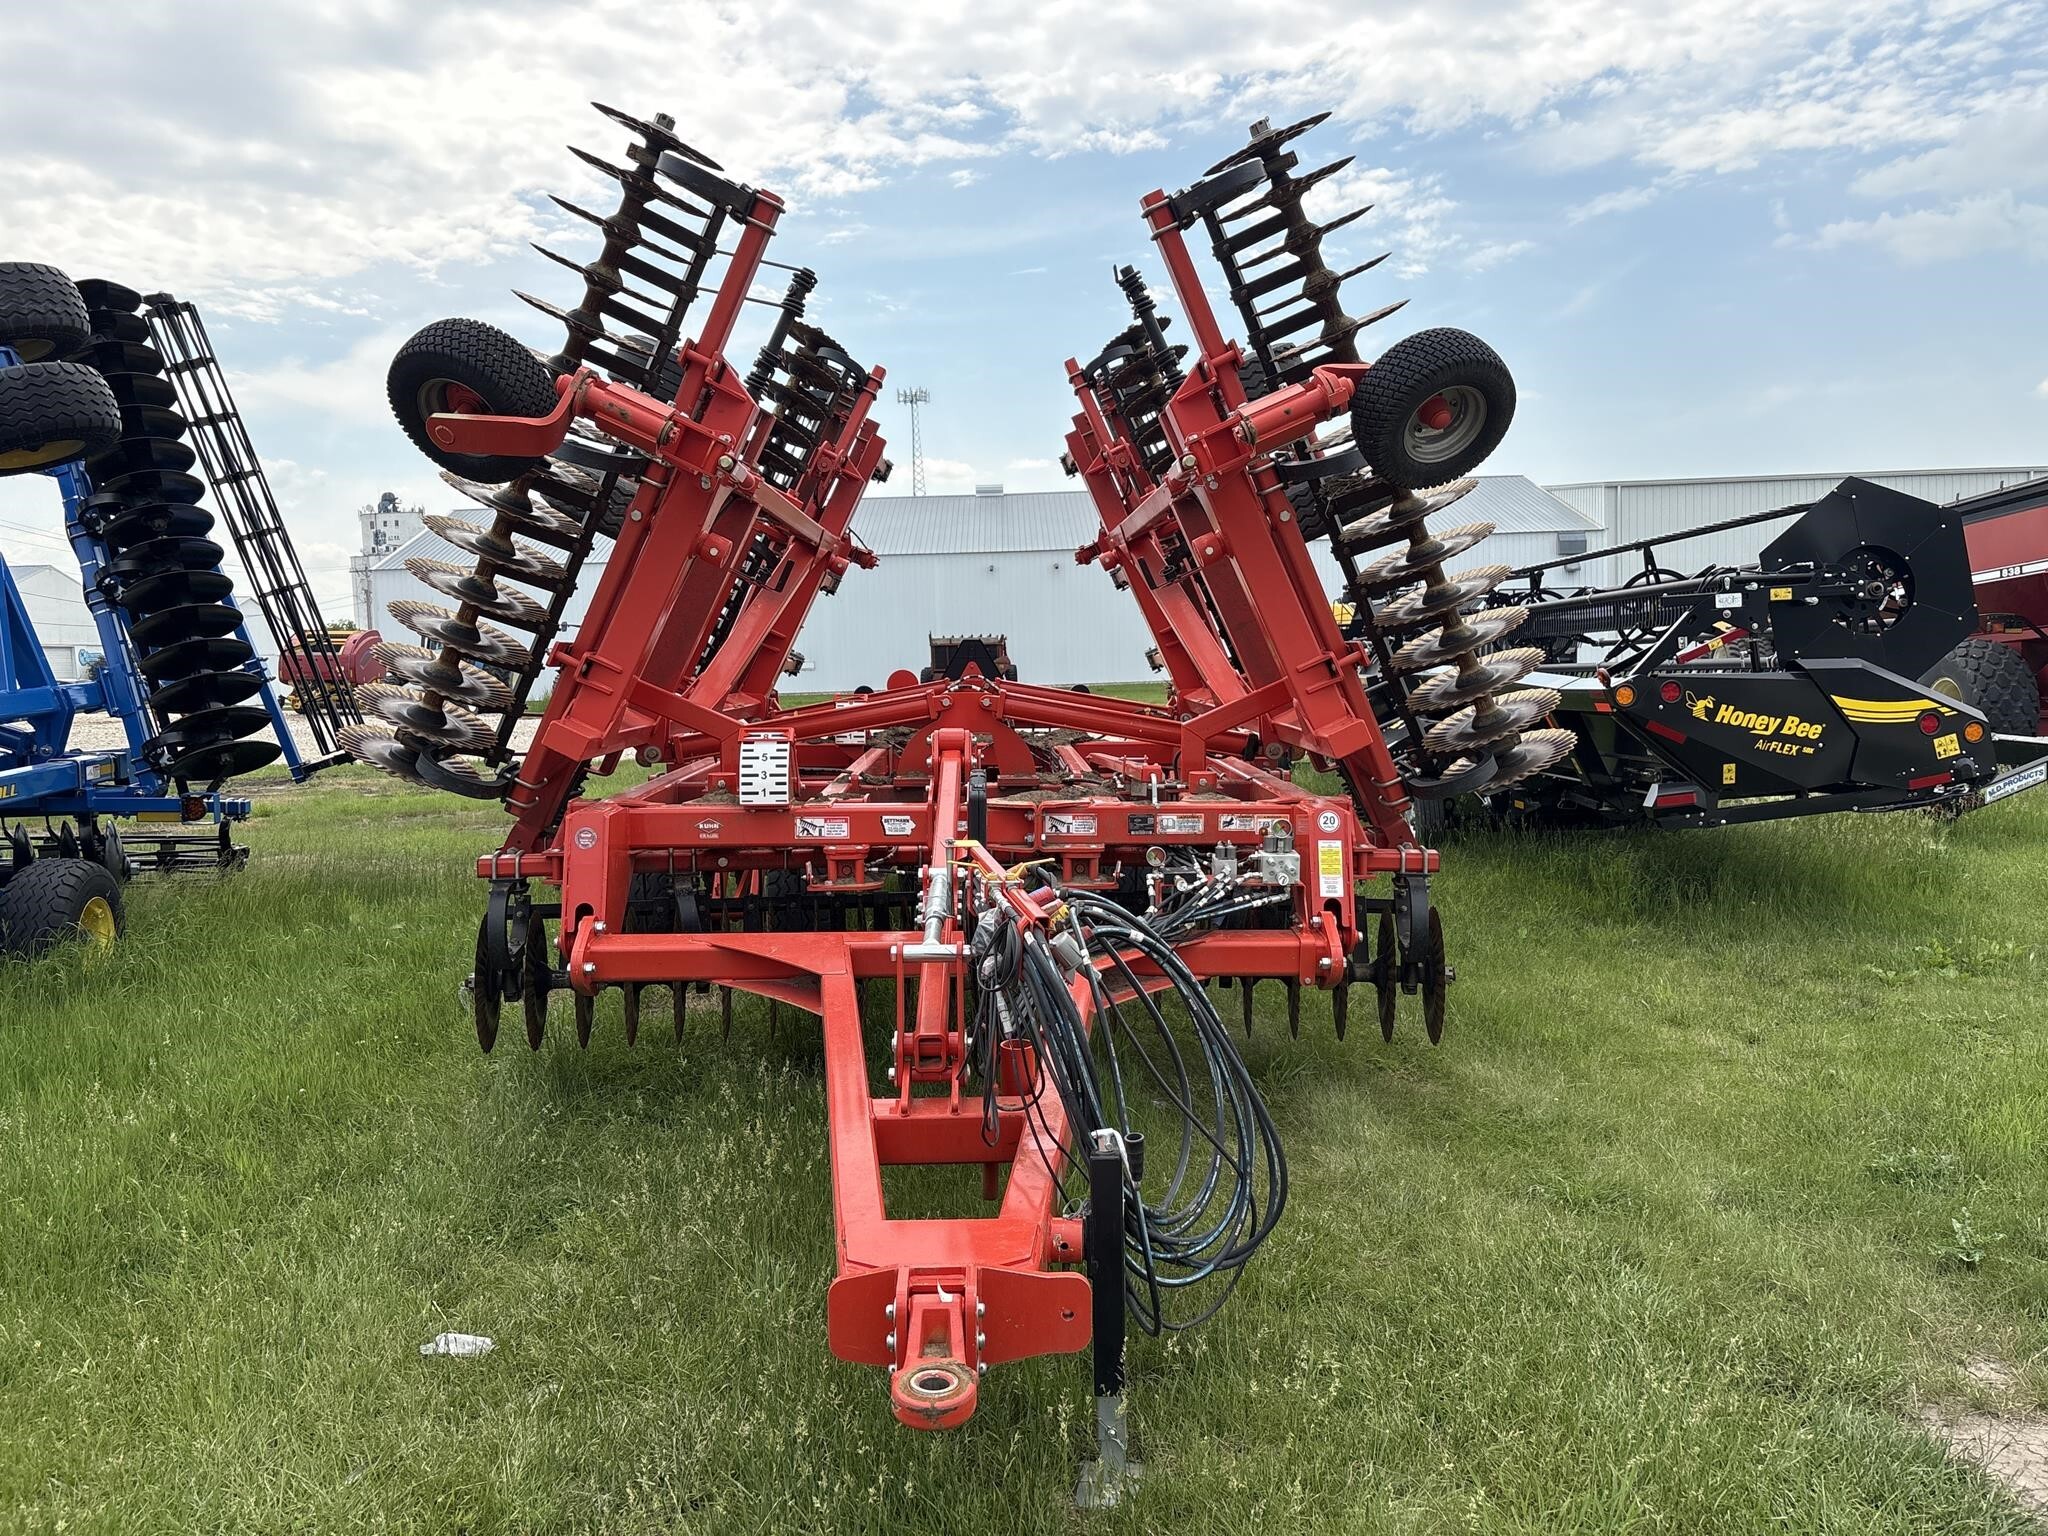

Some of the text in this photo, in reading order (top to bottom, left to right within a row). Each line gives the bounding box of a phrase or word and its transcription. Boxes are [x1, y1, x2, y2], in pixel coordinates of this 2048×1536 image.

[2001, 566, 2021, 577] 838
[1714, 703, 1823, 740] Honey Bee
[1754, 738, 1799, 756] AirFLEX
[761, 752, 768, 762] 5
[760, 770, 768, 780] 3
[760, 787, 767, 798] 1
[1322, 815, 1336, 825] 20
